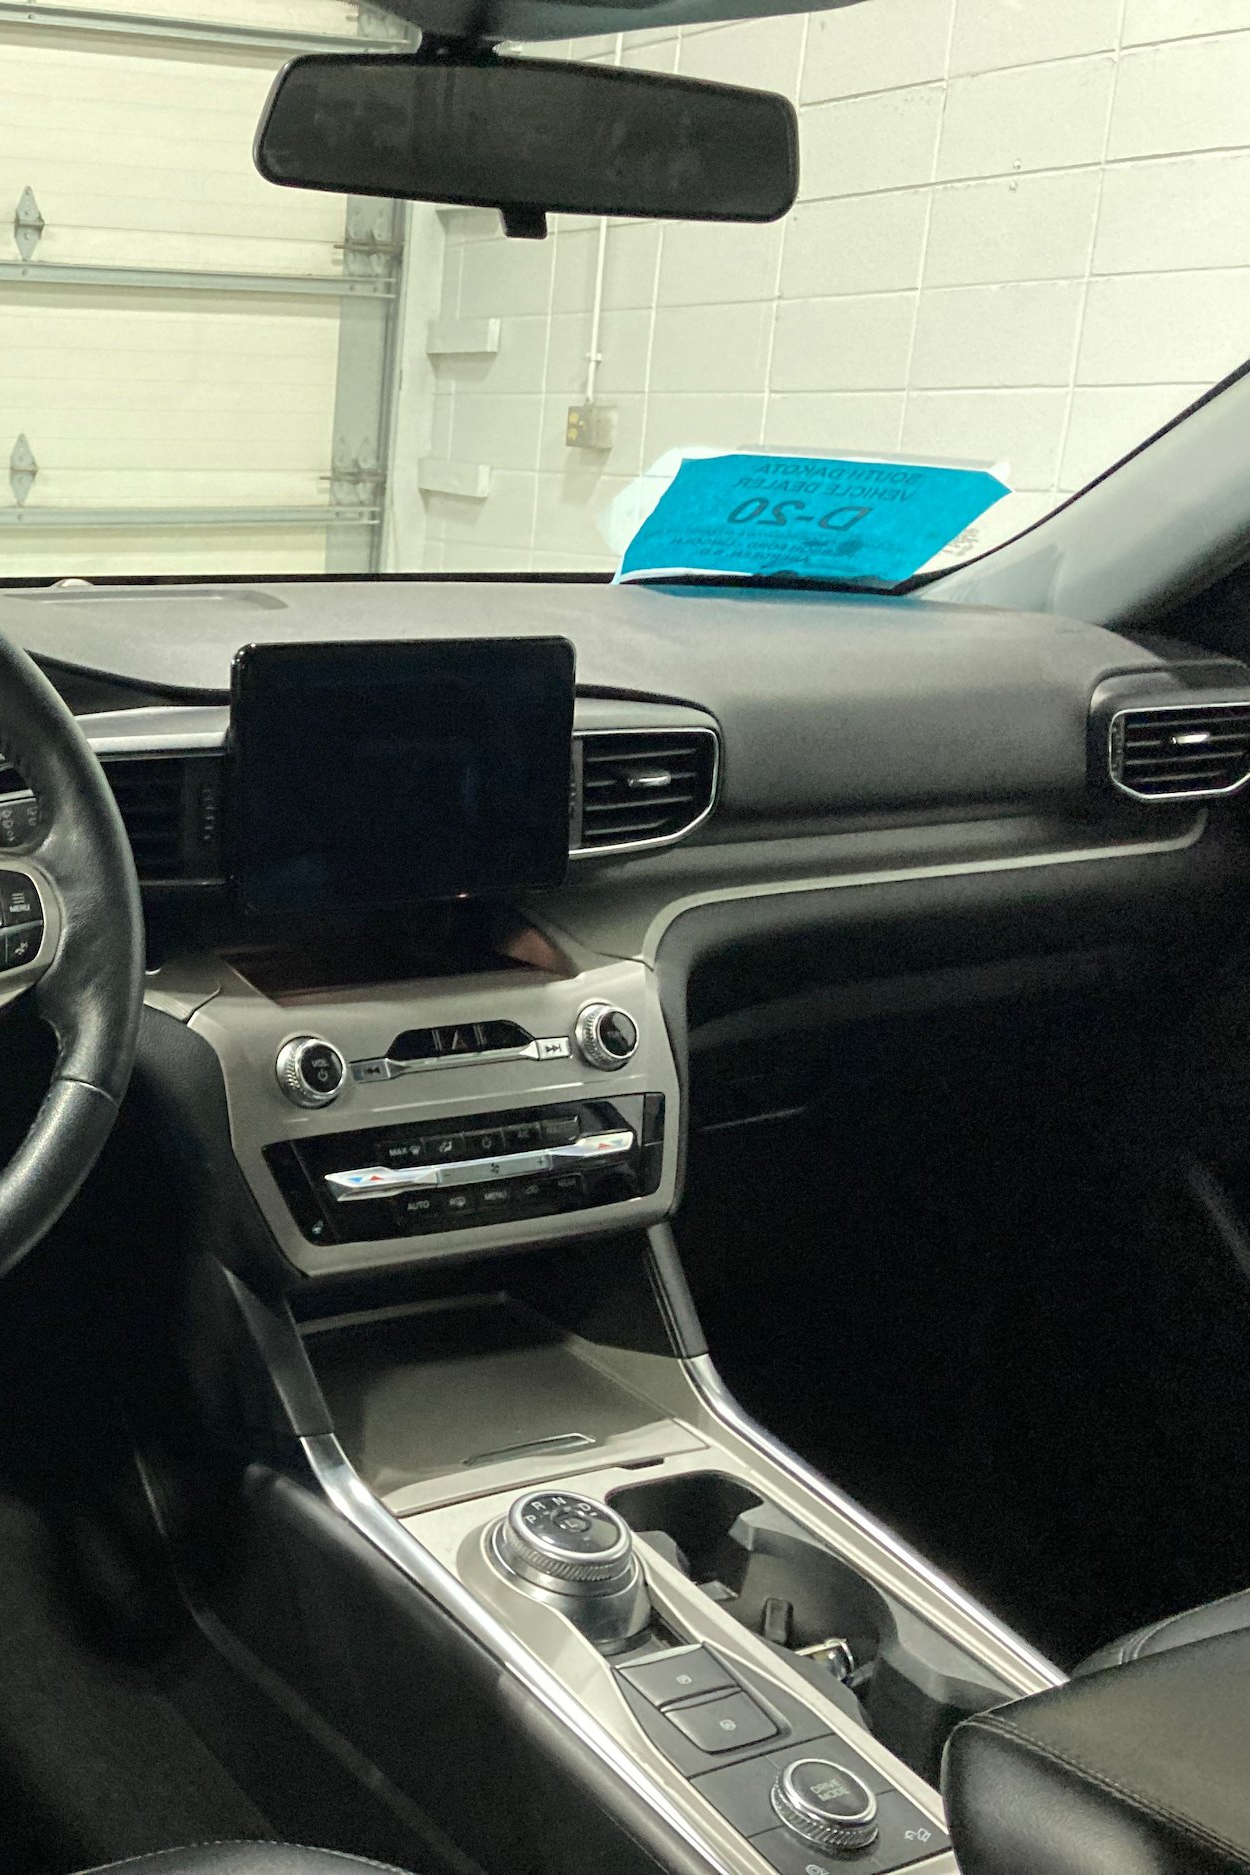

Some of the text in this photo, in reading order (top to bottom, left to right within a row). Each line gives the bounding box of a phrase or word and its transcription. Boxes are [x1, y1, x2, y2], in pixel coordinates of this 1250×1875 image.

[9, 903, 31, 913] MENU
[311, 1058, 329, 1068] VOL
[484, 1191, 507, 1201] MENU
[407, 1200, 430, 1211] AUTO
[530, 1501, 546, 1511] R
[551, 1496, 567, 1506] N
[577, 1502, 592, 1511] D
[525, 1514, 537, 1524] P
[810, 1778, 842, 1794] DRIVE
[817, 1786, 850, 1802] MODE
